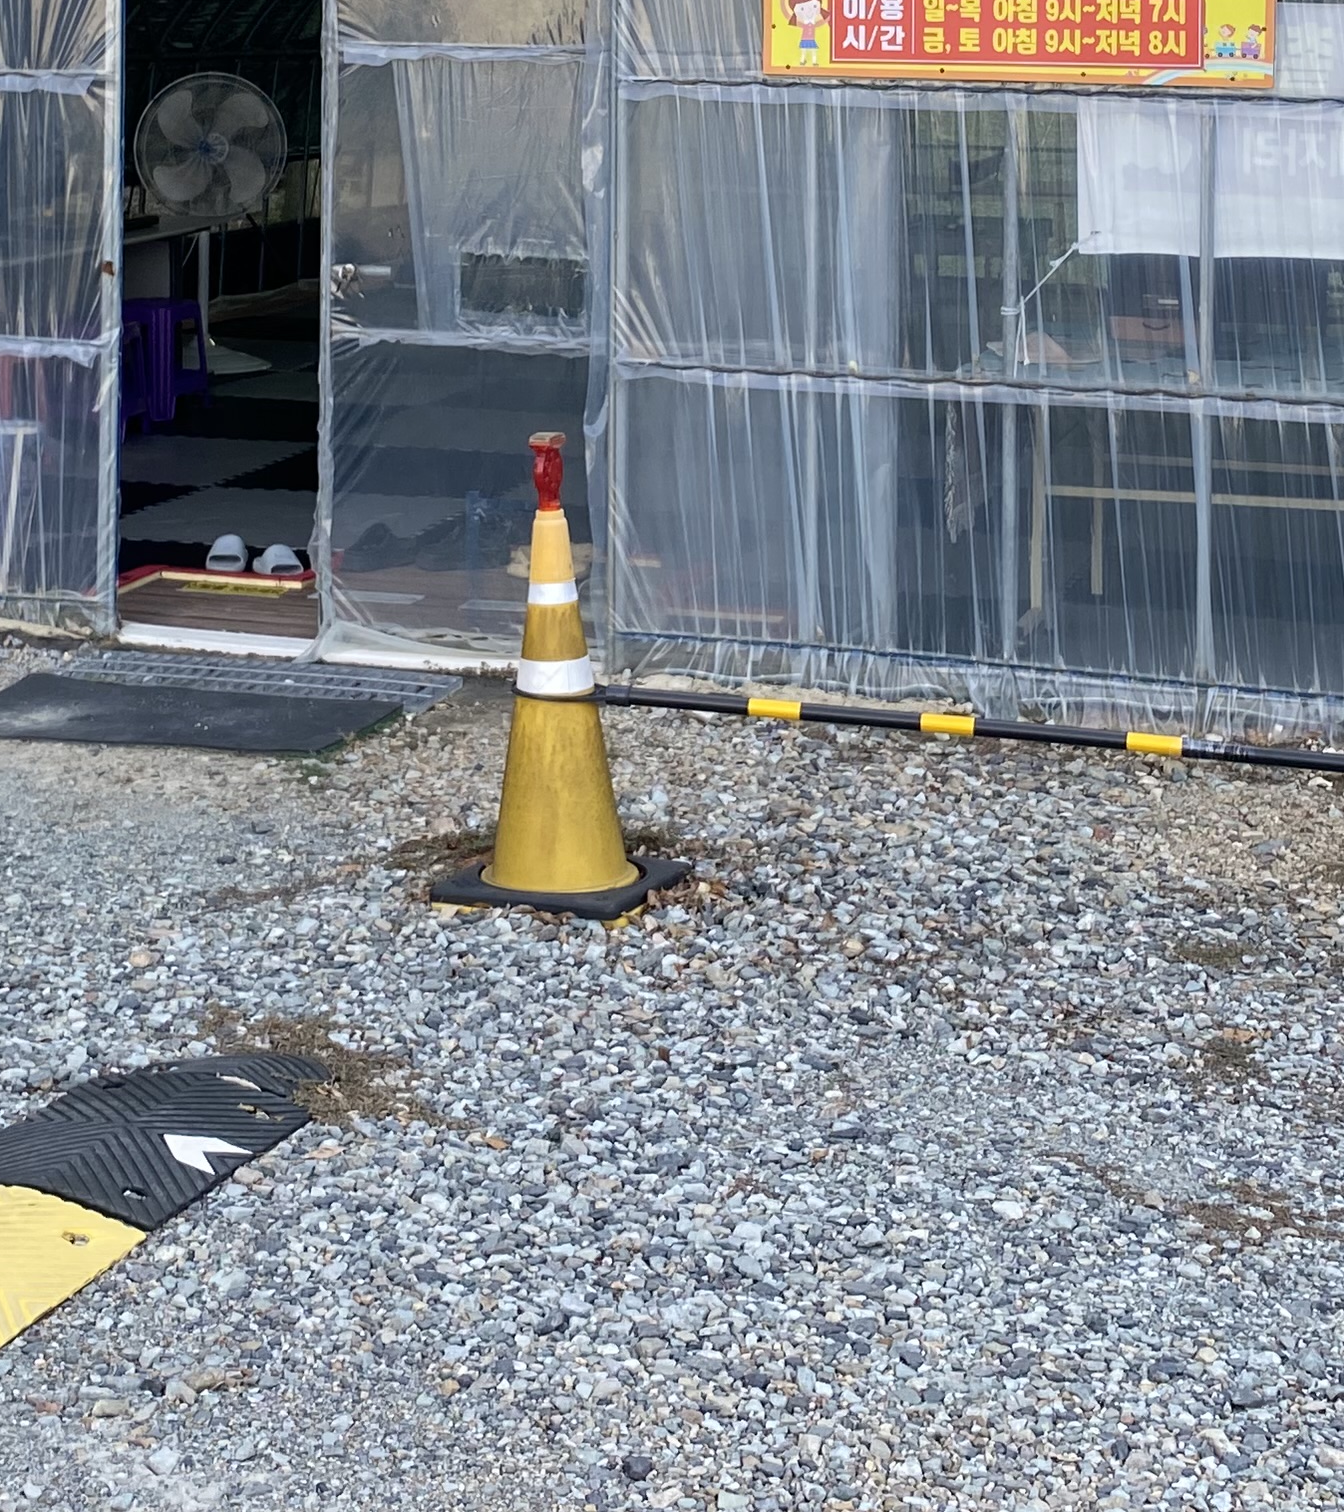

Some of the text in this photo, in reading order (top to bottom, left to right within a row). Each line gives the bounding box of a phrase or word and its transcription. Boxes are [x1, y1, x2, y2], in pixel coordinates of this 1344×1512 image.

[842, 24, 906, 52] 시/간
[992, 27, 1038, 55] 아침
[1044, 29, 1141, 56] 9시~저녁
[1148, 30, 1187, 57] 8시
